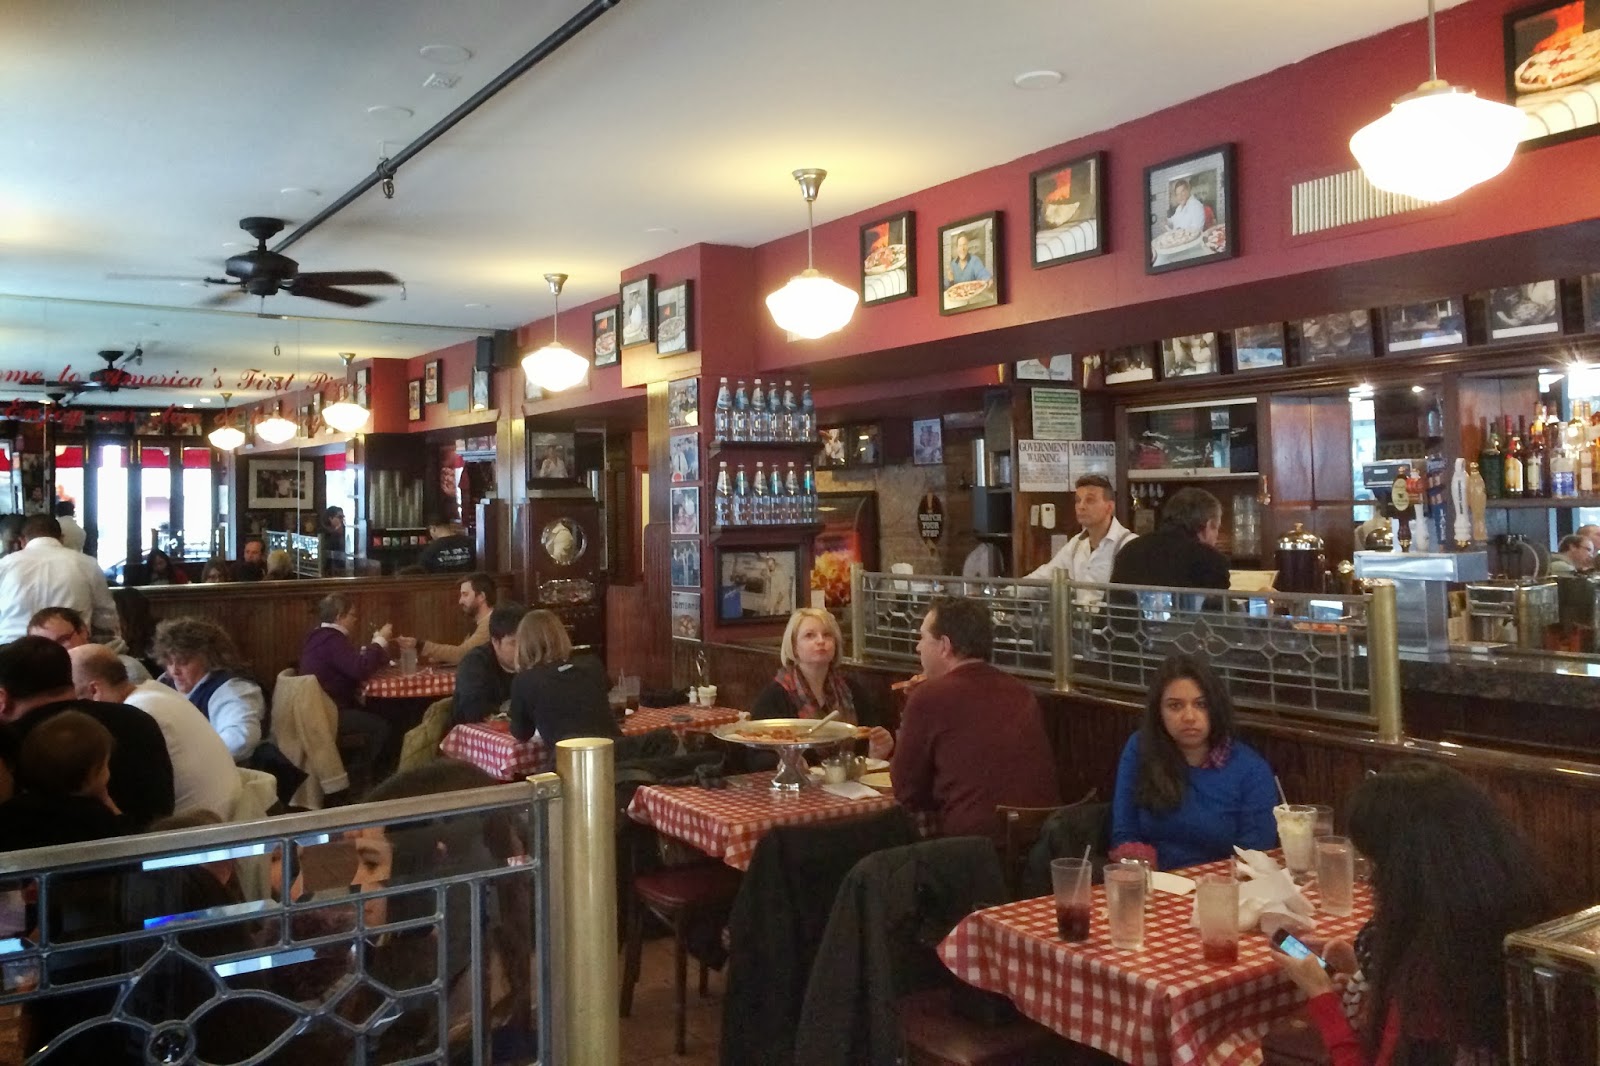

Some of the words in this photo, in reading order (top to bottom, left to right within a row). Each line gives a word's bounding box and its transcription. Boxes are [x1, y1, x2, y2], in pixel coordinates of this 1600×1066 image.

[58, 364, 80, 384] to
[93, 366, 223, 388] America's
[237, 368, 296, 391] First
[1020, 442, 1068, 453] GOVERNMENT
[1071, 443, 1115, 457] WARNING
[920, 513, 942, 521] WATCH
[921, 521, 940, 530] YOUR
[921, 529, 940, 538] STEP
